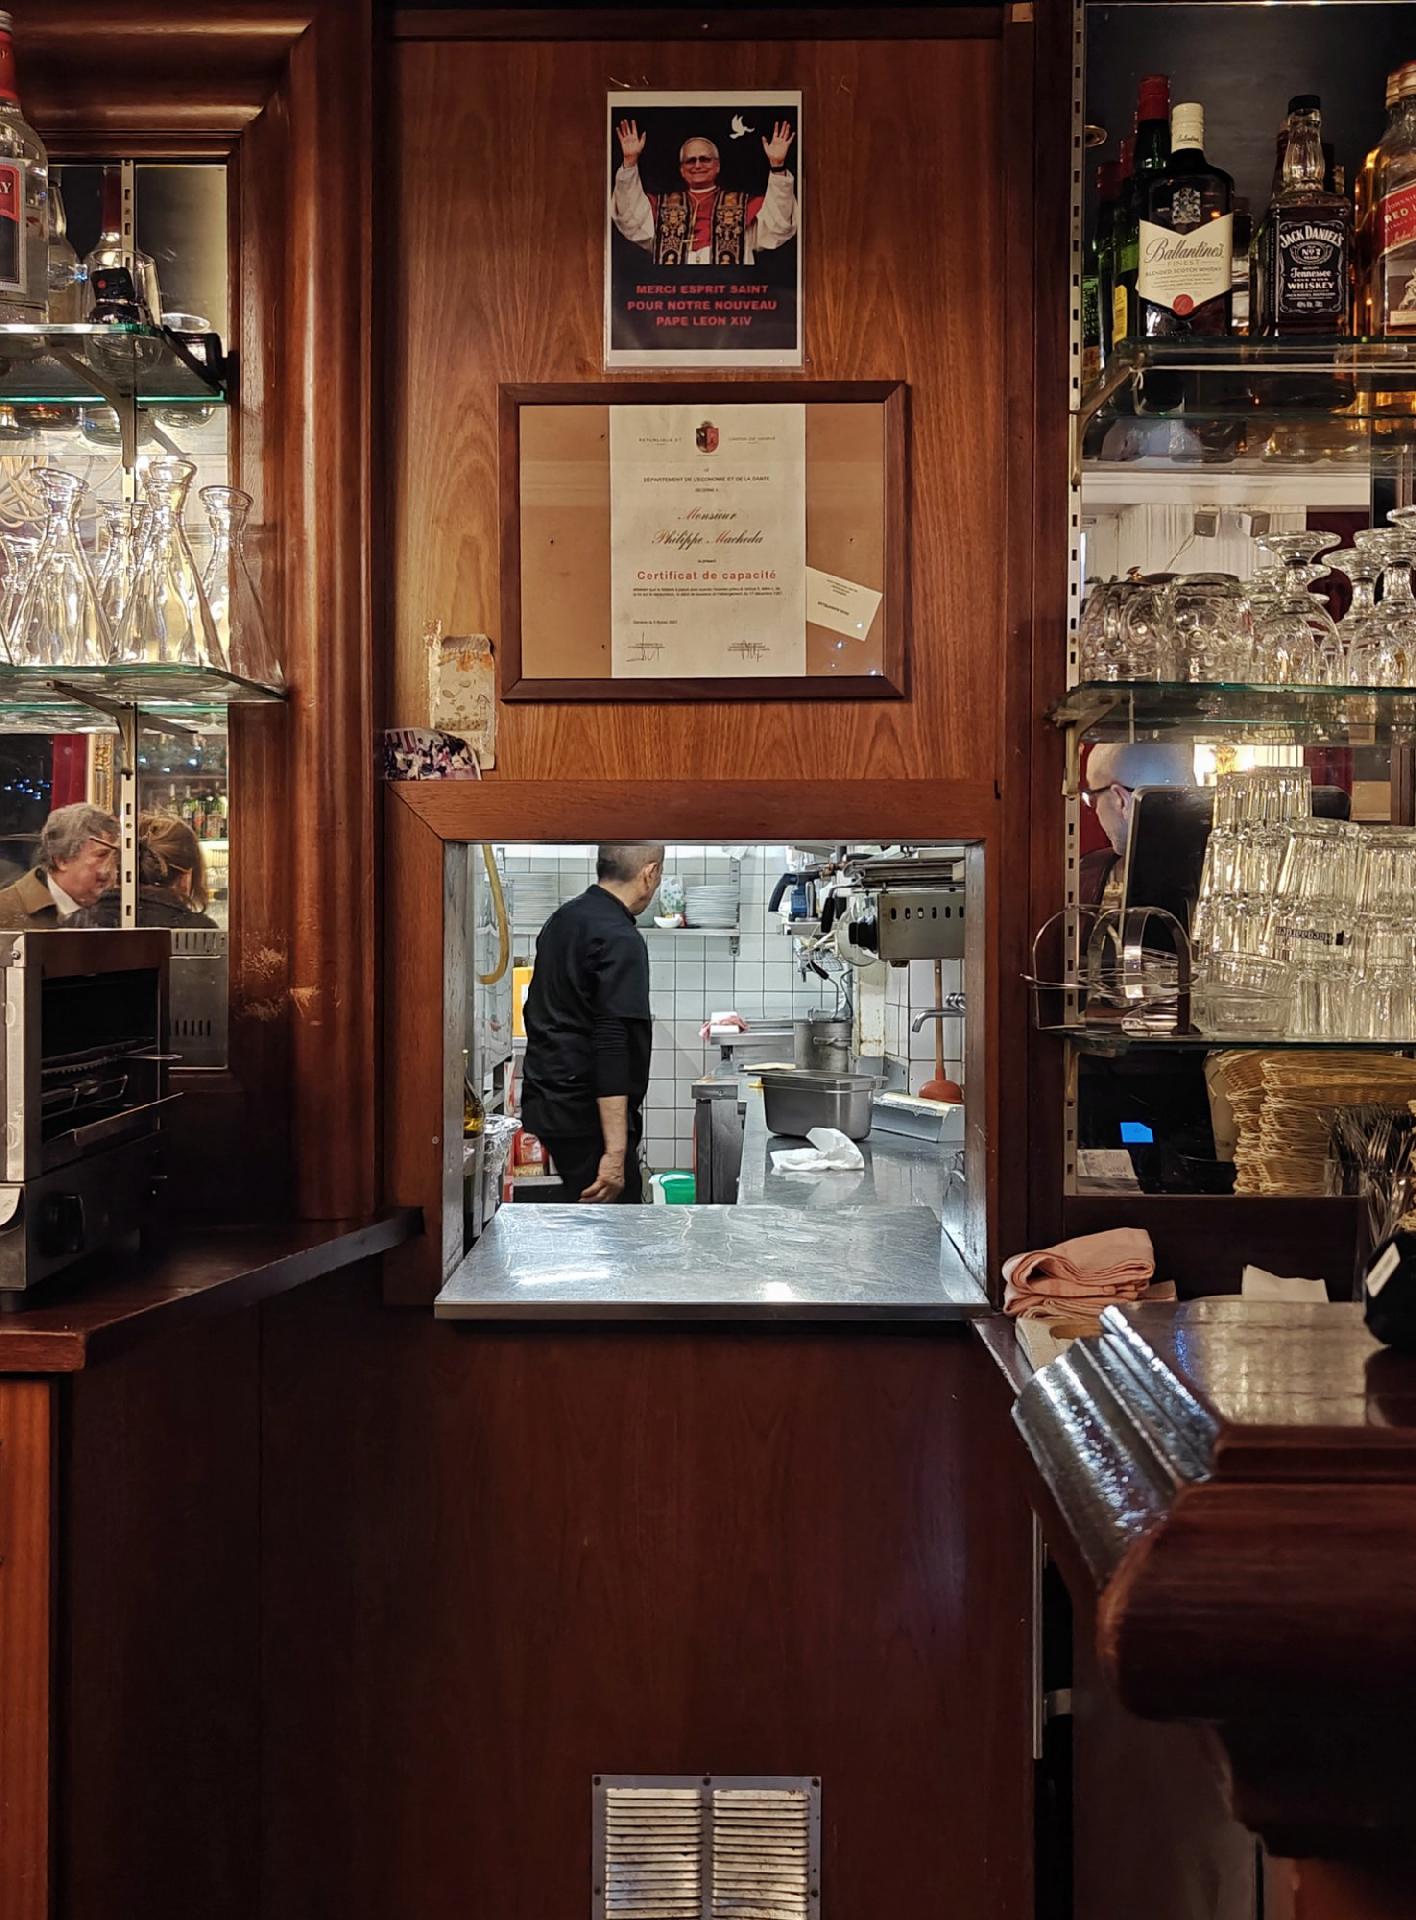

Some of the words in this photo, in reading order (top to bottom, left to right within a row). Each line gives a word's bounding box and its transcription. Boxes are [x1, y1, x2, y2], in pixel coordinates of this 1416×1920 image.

[1279, 229, 1305, 249] JACK
[1305, 225, 1345, 248] DANIEL'S
[1143, 237, 1225, 264] Ballantine's
[1290, 267, 1332, 278] Tennessee
[636, 285, 676, 294] MERCI
[680, 285, 725, 294] ESPRIT
[730, 285, 769, 294] SAINT
[627, 301, 663, 310] POUR
[667, 301, 711, 310] NOTRE
[714, 301, 777, 310] NOUVEAU
[656, 316, 689, 326] PAPE
[693, 316, 727, 326] LEON
[730, 316, 752, 326] XIV
[677, 506, 737, 520] Monsieur
[652, 529, 703, 551] Philippe
[637, 570, 697, 580] Certificat
[702, 571, 718, 580] de
[722, 570, 777, 582] capacité
